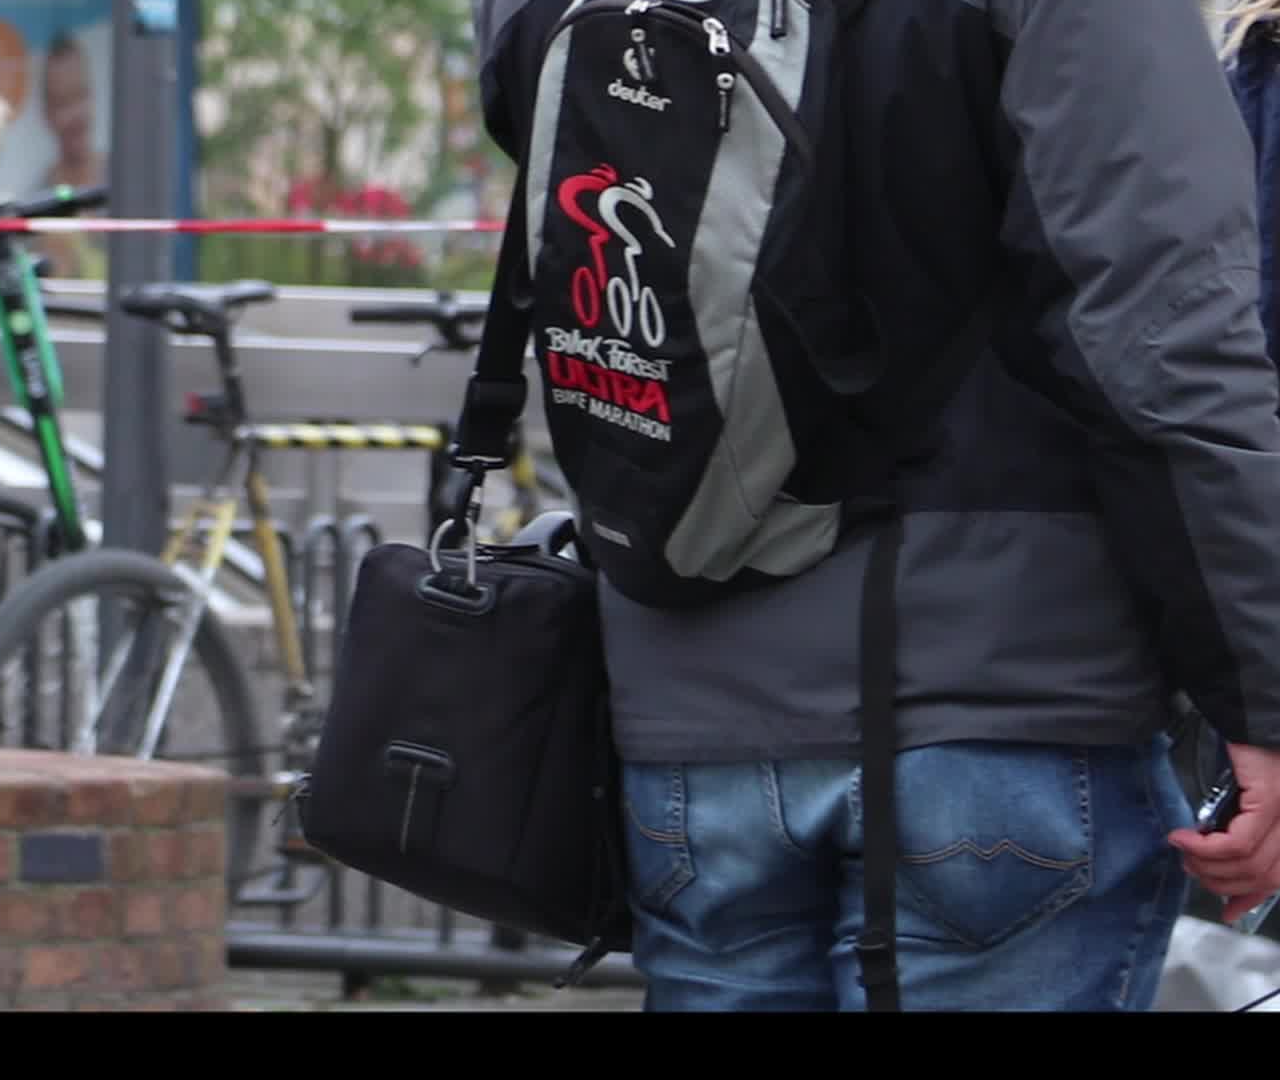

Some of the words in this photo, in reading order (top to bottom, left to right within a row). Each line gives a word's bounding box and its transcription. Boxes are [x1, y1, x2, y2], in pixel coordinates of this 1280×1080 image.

[607, 77, 673, 112] deuter
[602, 338, 673, 382] FOREST
[545, 350, 672, 424] ULTRA
[551, 387, 588, 409] BIKE
[588, 396, 672, 442] MARATHON
